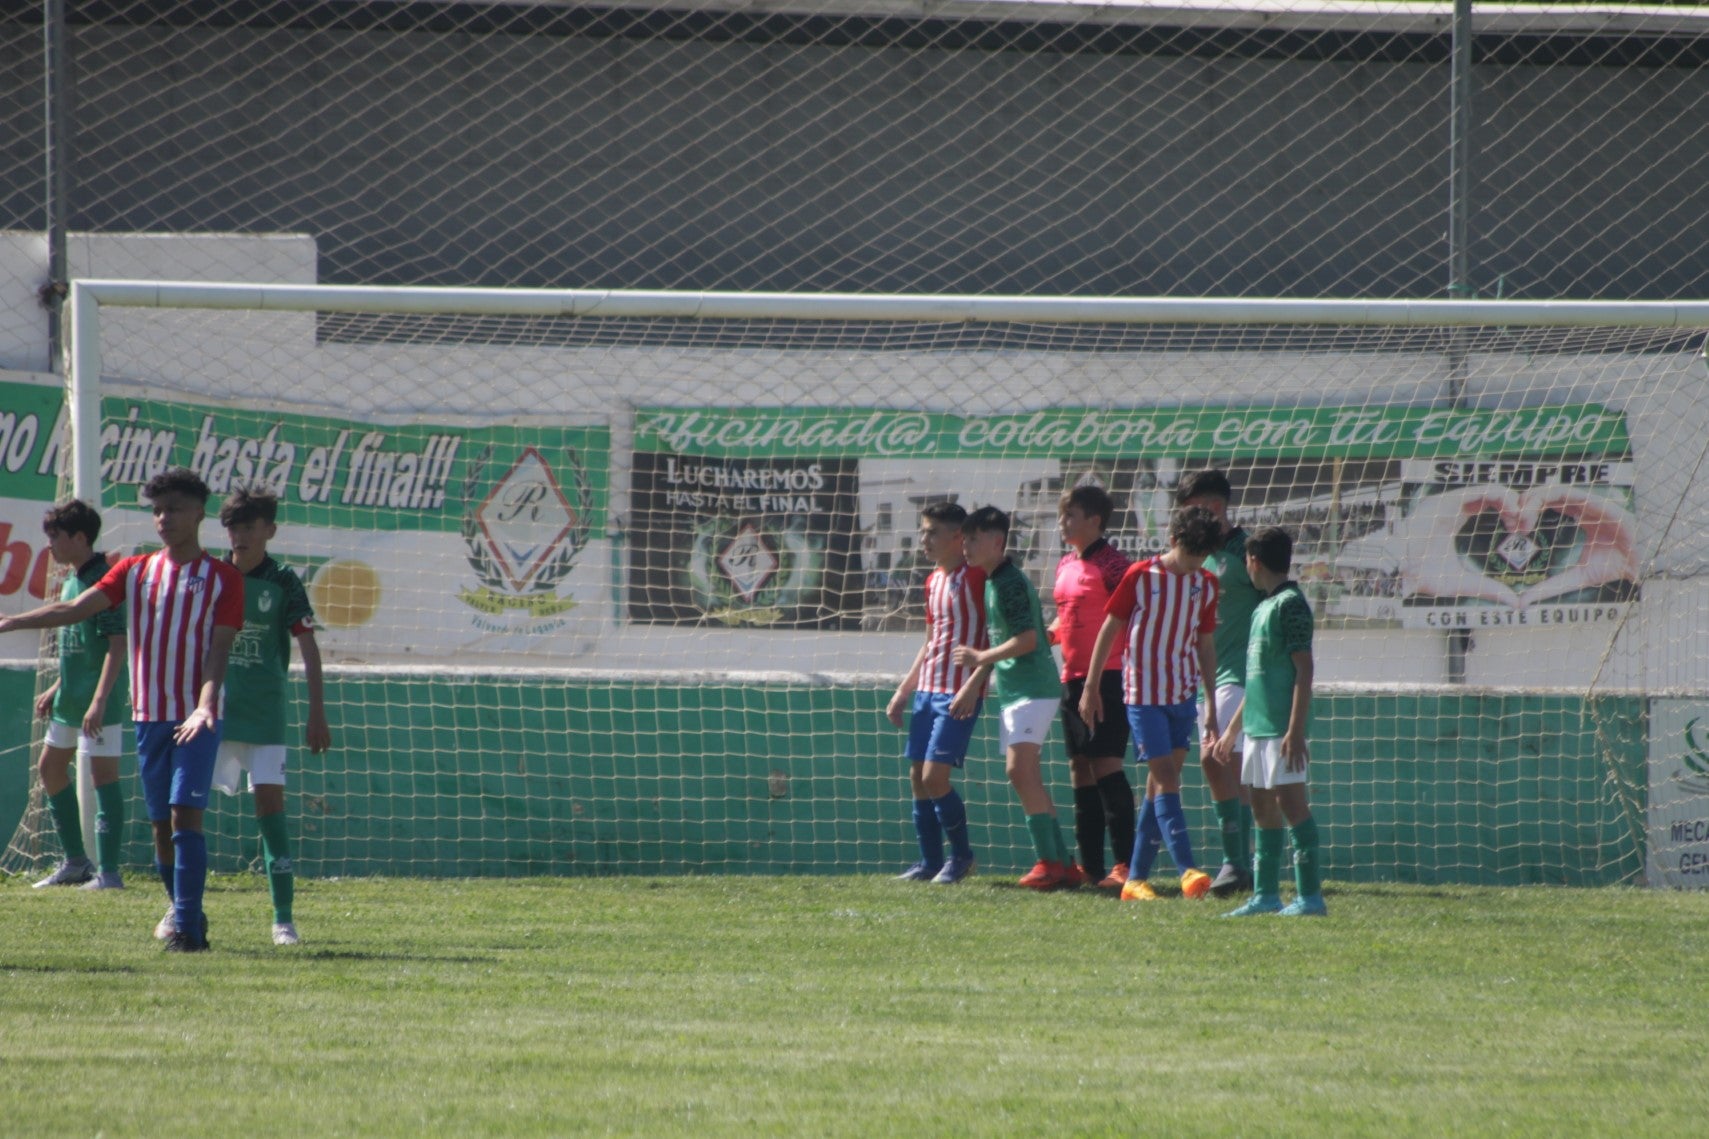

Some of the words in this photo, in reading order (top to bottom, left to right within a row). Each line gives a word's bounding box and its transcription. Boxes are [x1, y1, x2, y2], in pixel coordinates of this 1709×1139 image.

[959, 411, 1201, 447] colabora
[1212, 417, 1318, 445] con
[1412, 410, 1614, 452] Equipo
[191, 414, 295, 498] hasta
[299, 429, 350, 502] el
[1434, 462, 1610, 485] SIEMPRE
[666, 490, 729, 507] HASTA
[733, 493, 755, 511] EL
[759, 496, 823, 512] FINAL
[1426, 612, 1467, 627] CON
[1480, 611, 1527, 625] ESTE
[1540, 607, 1618, 623] EQUIPO
